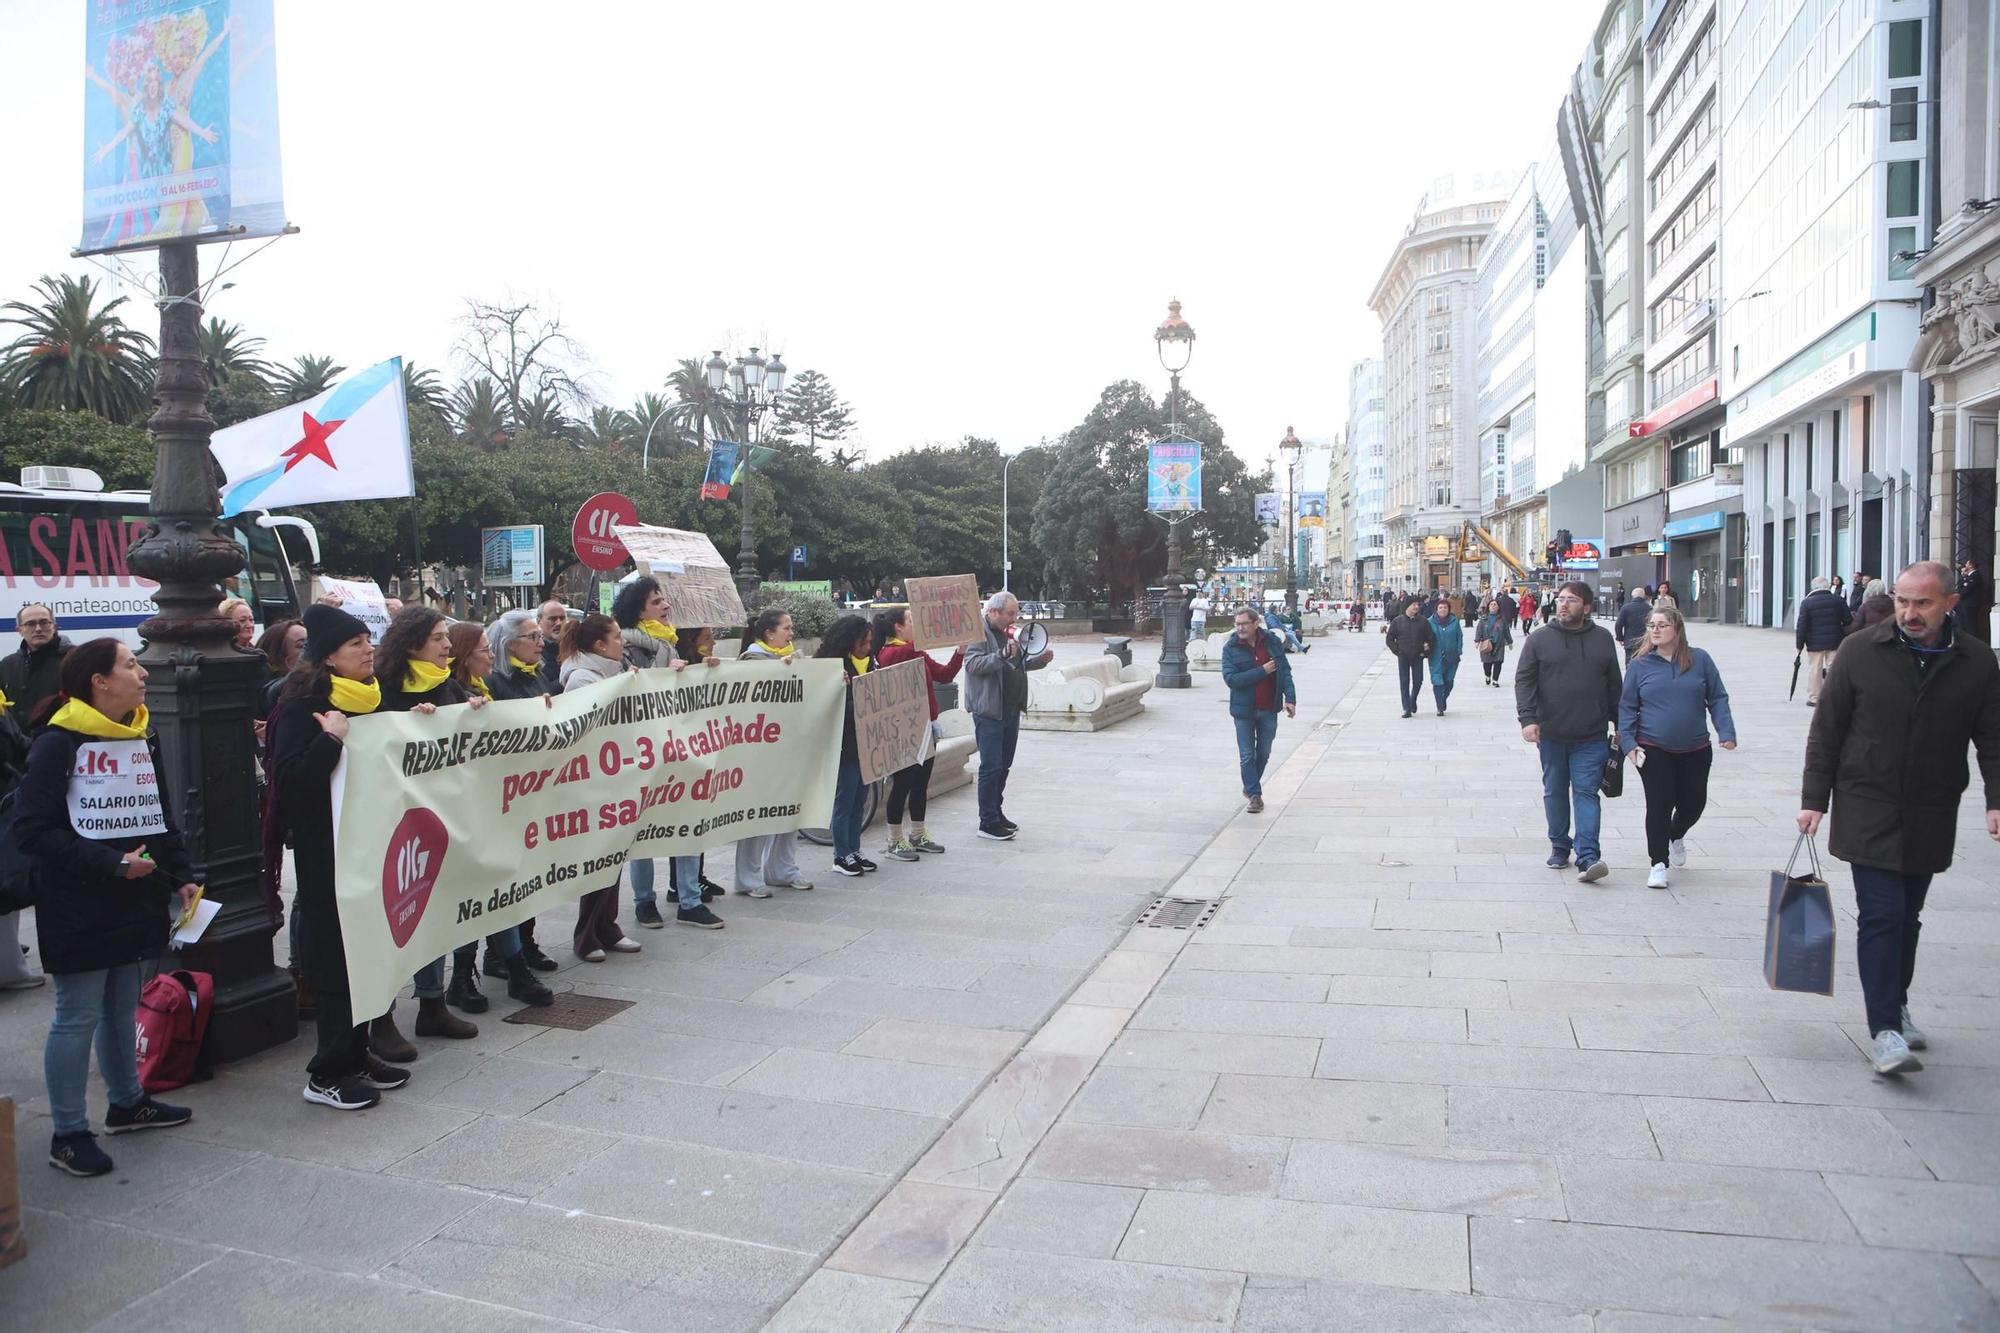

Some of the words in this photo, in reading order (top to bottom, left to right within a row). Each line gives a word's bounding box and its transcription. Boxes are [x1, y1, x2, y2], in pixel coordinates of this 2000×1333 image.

[402, 737, 449, 777] REDE
[470, 724, 551, 761] ESCOLAS
[731, 681, 751, 704] DA
[751, 674, 804, 703] CORUÑA
[502, 767, 554, 814] por
[599, 736, 656, 775] 0-3
[662, 729, 689, 765] de
[688, 713, 782, 758] calidade
[77, 815, 139, 831] XORNADA
[80, 795, 136, 810] SALARIO
[524, 821, 539, 850] e
[545, 808, 590, 842] un
[456, 898, 482, 925] Na
[487, 874, 542, 913] defensa
[546, 863, 578, 886] dos
[679, 823, 689, 837] e
[711, 808, 744, 830] nenos
[747, 807, 756, 820] e
[758, 803, 802, 819] nenas
